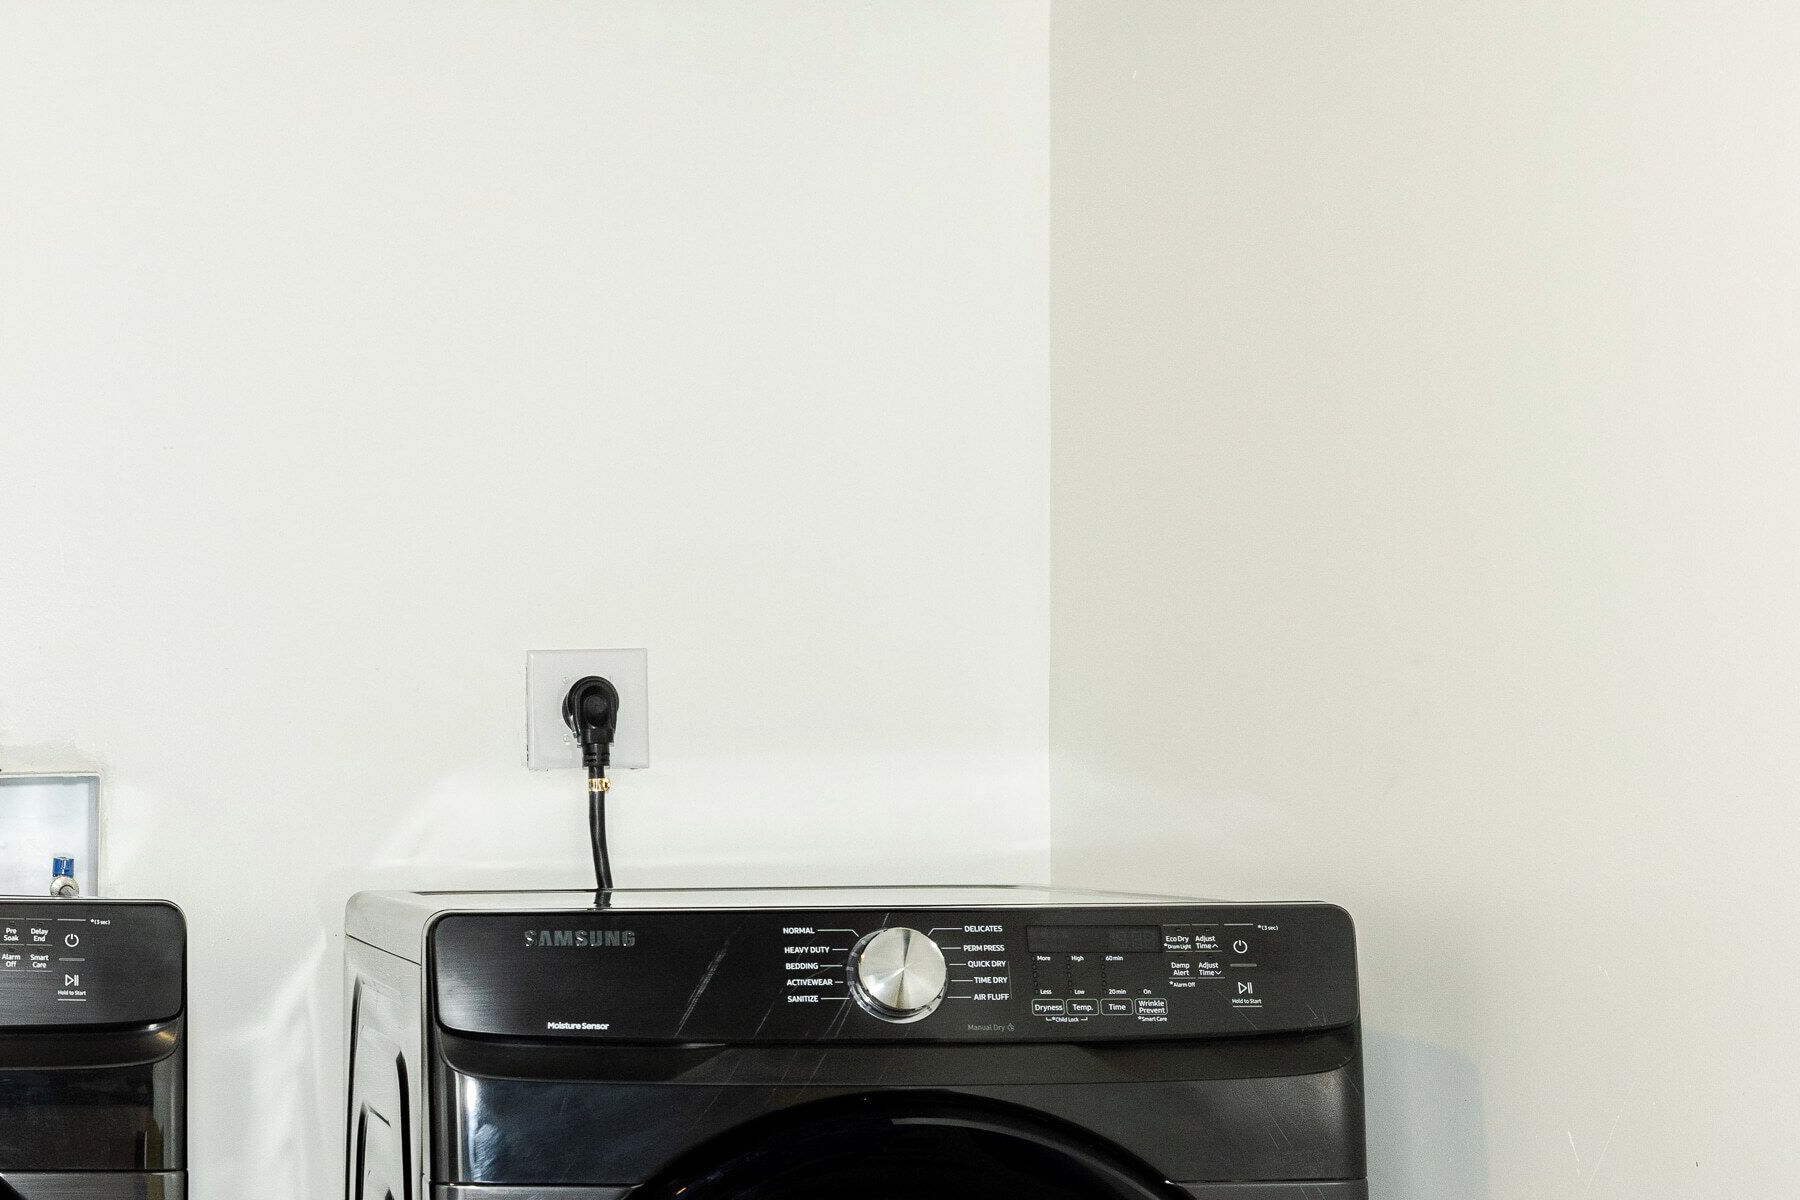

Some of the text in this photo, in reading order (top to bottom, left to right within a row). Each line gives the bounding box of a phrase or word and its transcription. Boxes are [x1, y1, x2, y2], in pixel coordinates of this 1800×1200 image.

[524, 930, 636, 947] SAMSUNG
[1177, 935, 1189, 943] Dry
[1195, 935, 1216, 943] Adjust
[784, 946, 809, 954] HEAVY
[785, 962, 819, 970] BEDDING
[967, 960, 991, 968] QUICK
[973, 976, 1008, 984] TIME DRY
[787, 995, 819, 1003] SANITIZE
[987, 993, 1010, 1001] FLUFF
[1034, 1003, 1063, 1012] Dryness
[1072, 1003, 1094, 1012] Temp.
[1108, 1003, 1127, 1011] Time
[1139, 1006, 1166, 1014] Prevent
[547, 1021, 610, 1030] Moisture Sensor
[993, 1024, 1006, 1032] Dry
